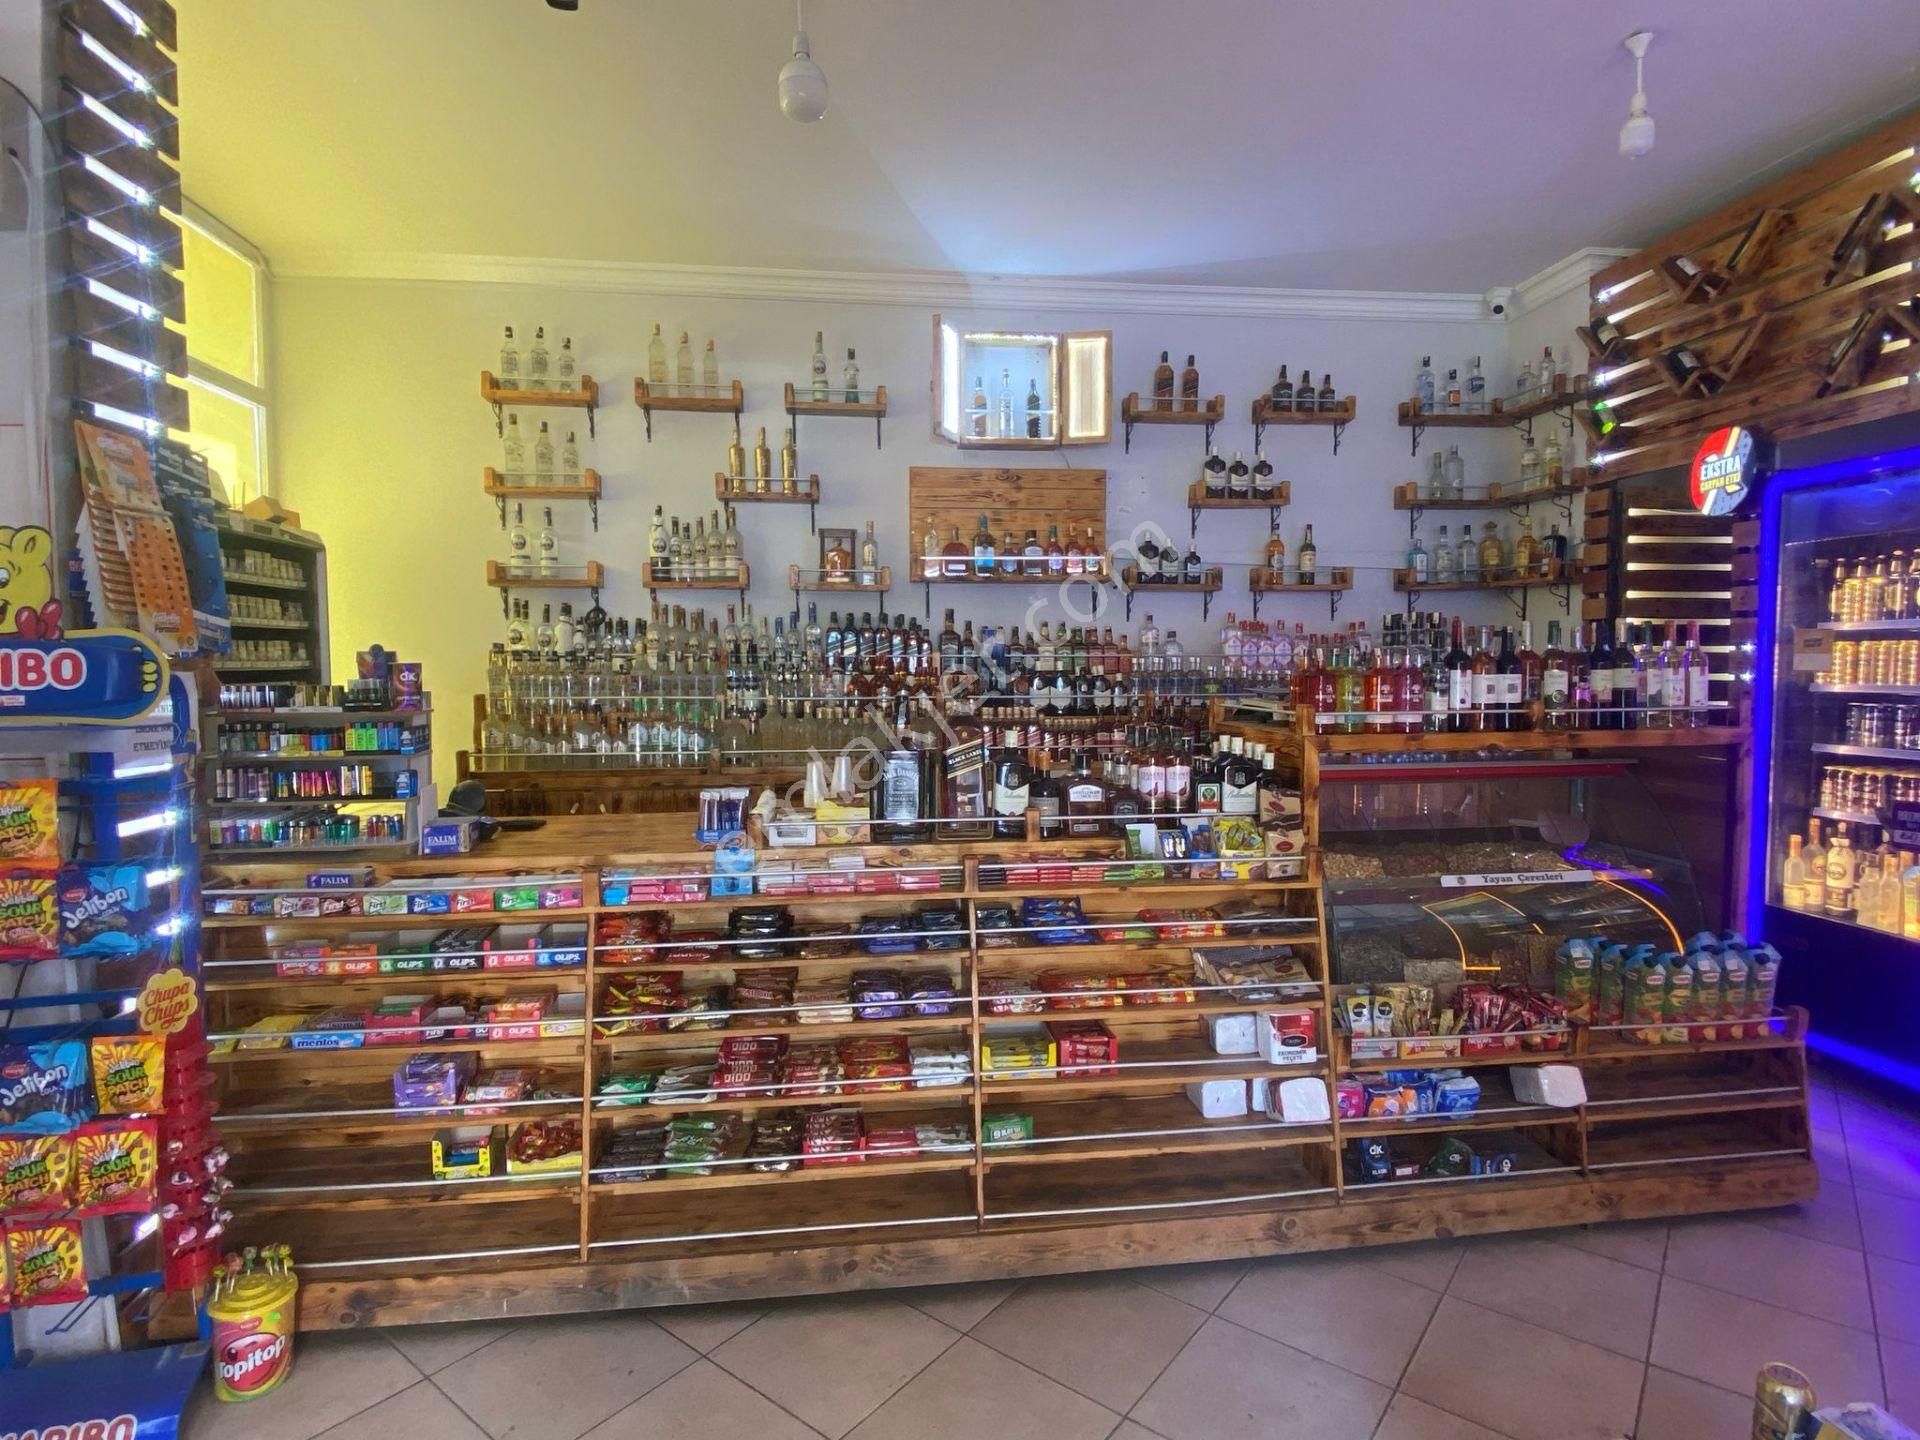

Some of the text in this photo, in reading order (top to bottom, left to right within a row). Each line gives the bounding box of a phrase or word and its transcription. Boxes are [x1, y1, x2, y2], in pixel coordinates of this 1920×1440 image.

[1701, 455, 1740, 481] EKSTRA
[967, 749, 982, 759] LABEL
[428, 836, 456, 846] FALIM
[321, 877, 349, 885] FALIM
[1482, 872, 1564, 885] Yayan Çerezleri
[62, 886, 128, 928] Jelibon
[145, 981, 190, 1006] Chupa
[144, 998, 190, 1029] Chups
[297, 1037, 340, 1047] mentos
[0, 1065, 68, 1106] Jelibon
[107, 1067, 145, 1083] SOUR
[108, 1078, 148, 1095] PATCH
[6, 1162, 46, 1183] SOUR
[91, 1157, 132, 1178] SOUR
[6, 1174, 49, 1192] PATCH
[94, 1168, 136, 1189] PATCH
[24, 1251, 61, 1273] SOUR
[218, 1335, 285, 1382] Topitop
